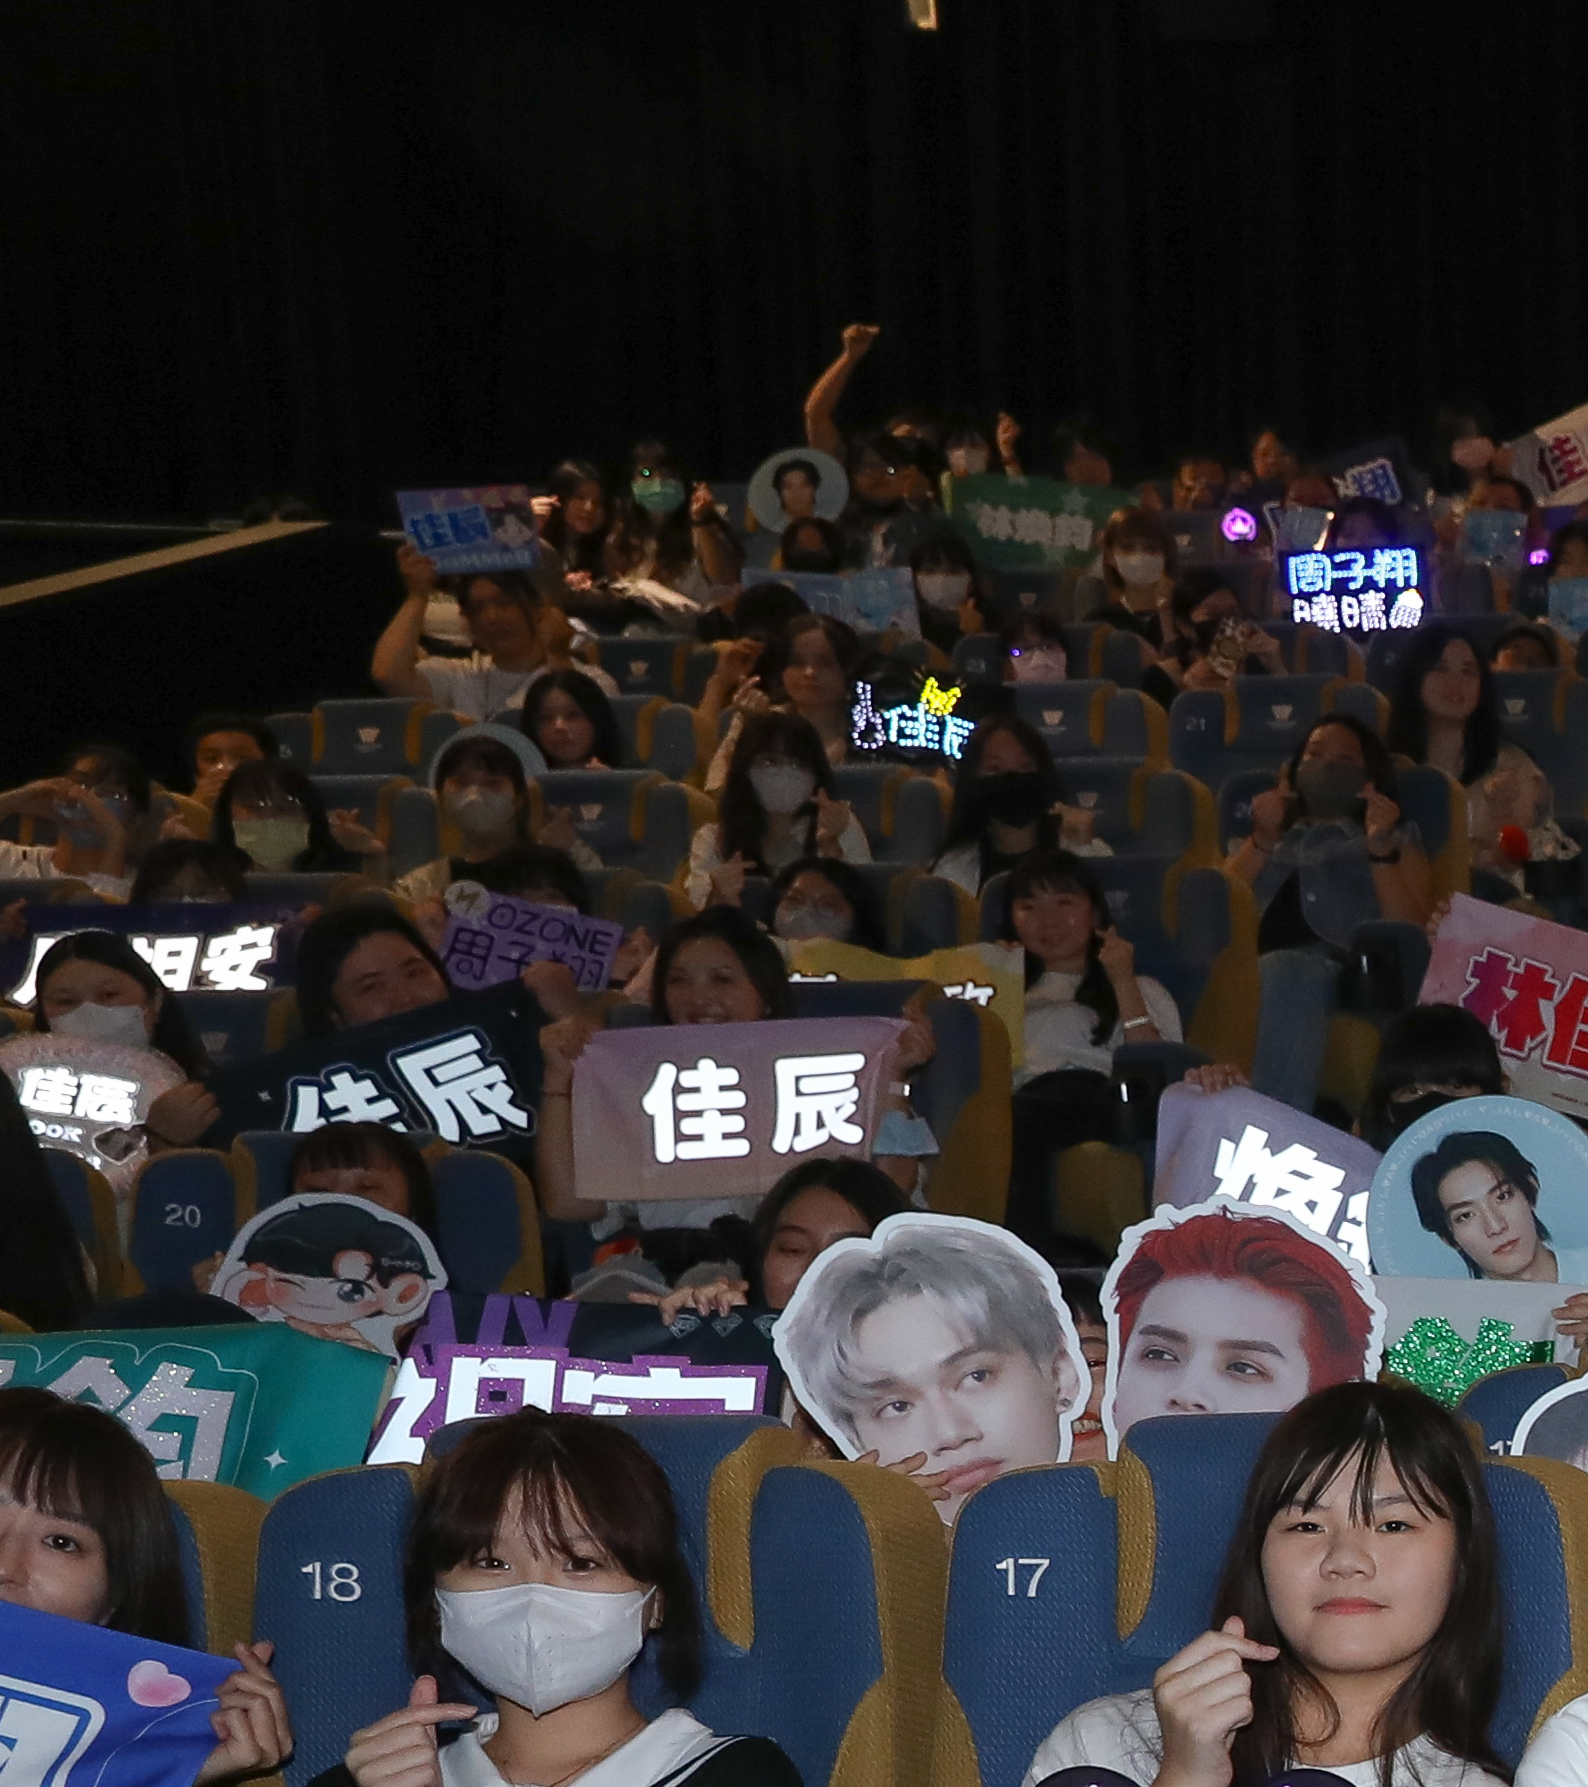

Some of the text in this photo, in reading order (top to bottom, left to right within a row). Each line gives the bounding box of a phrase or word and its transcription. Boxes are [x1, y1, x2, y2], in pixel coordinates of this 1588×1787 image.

[1287, 548, 1418, 593] 周子翔
[486, 902, 606, 966] OZONE
[20, 1066, 138, 1125] 佳辰
[642, 1053, 866, 1163] 佳辰
[163, 1203, 202, 1229] 20
[300, 1561, 363, 1603] 18
[995, 1558, 1050, 1598] 17
